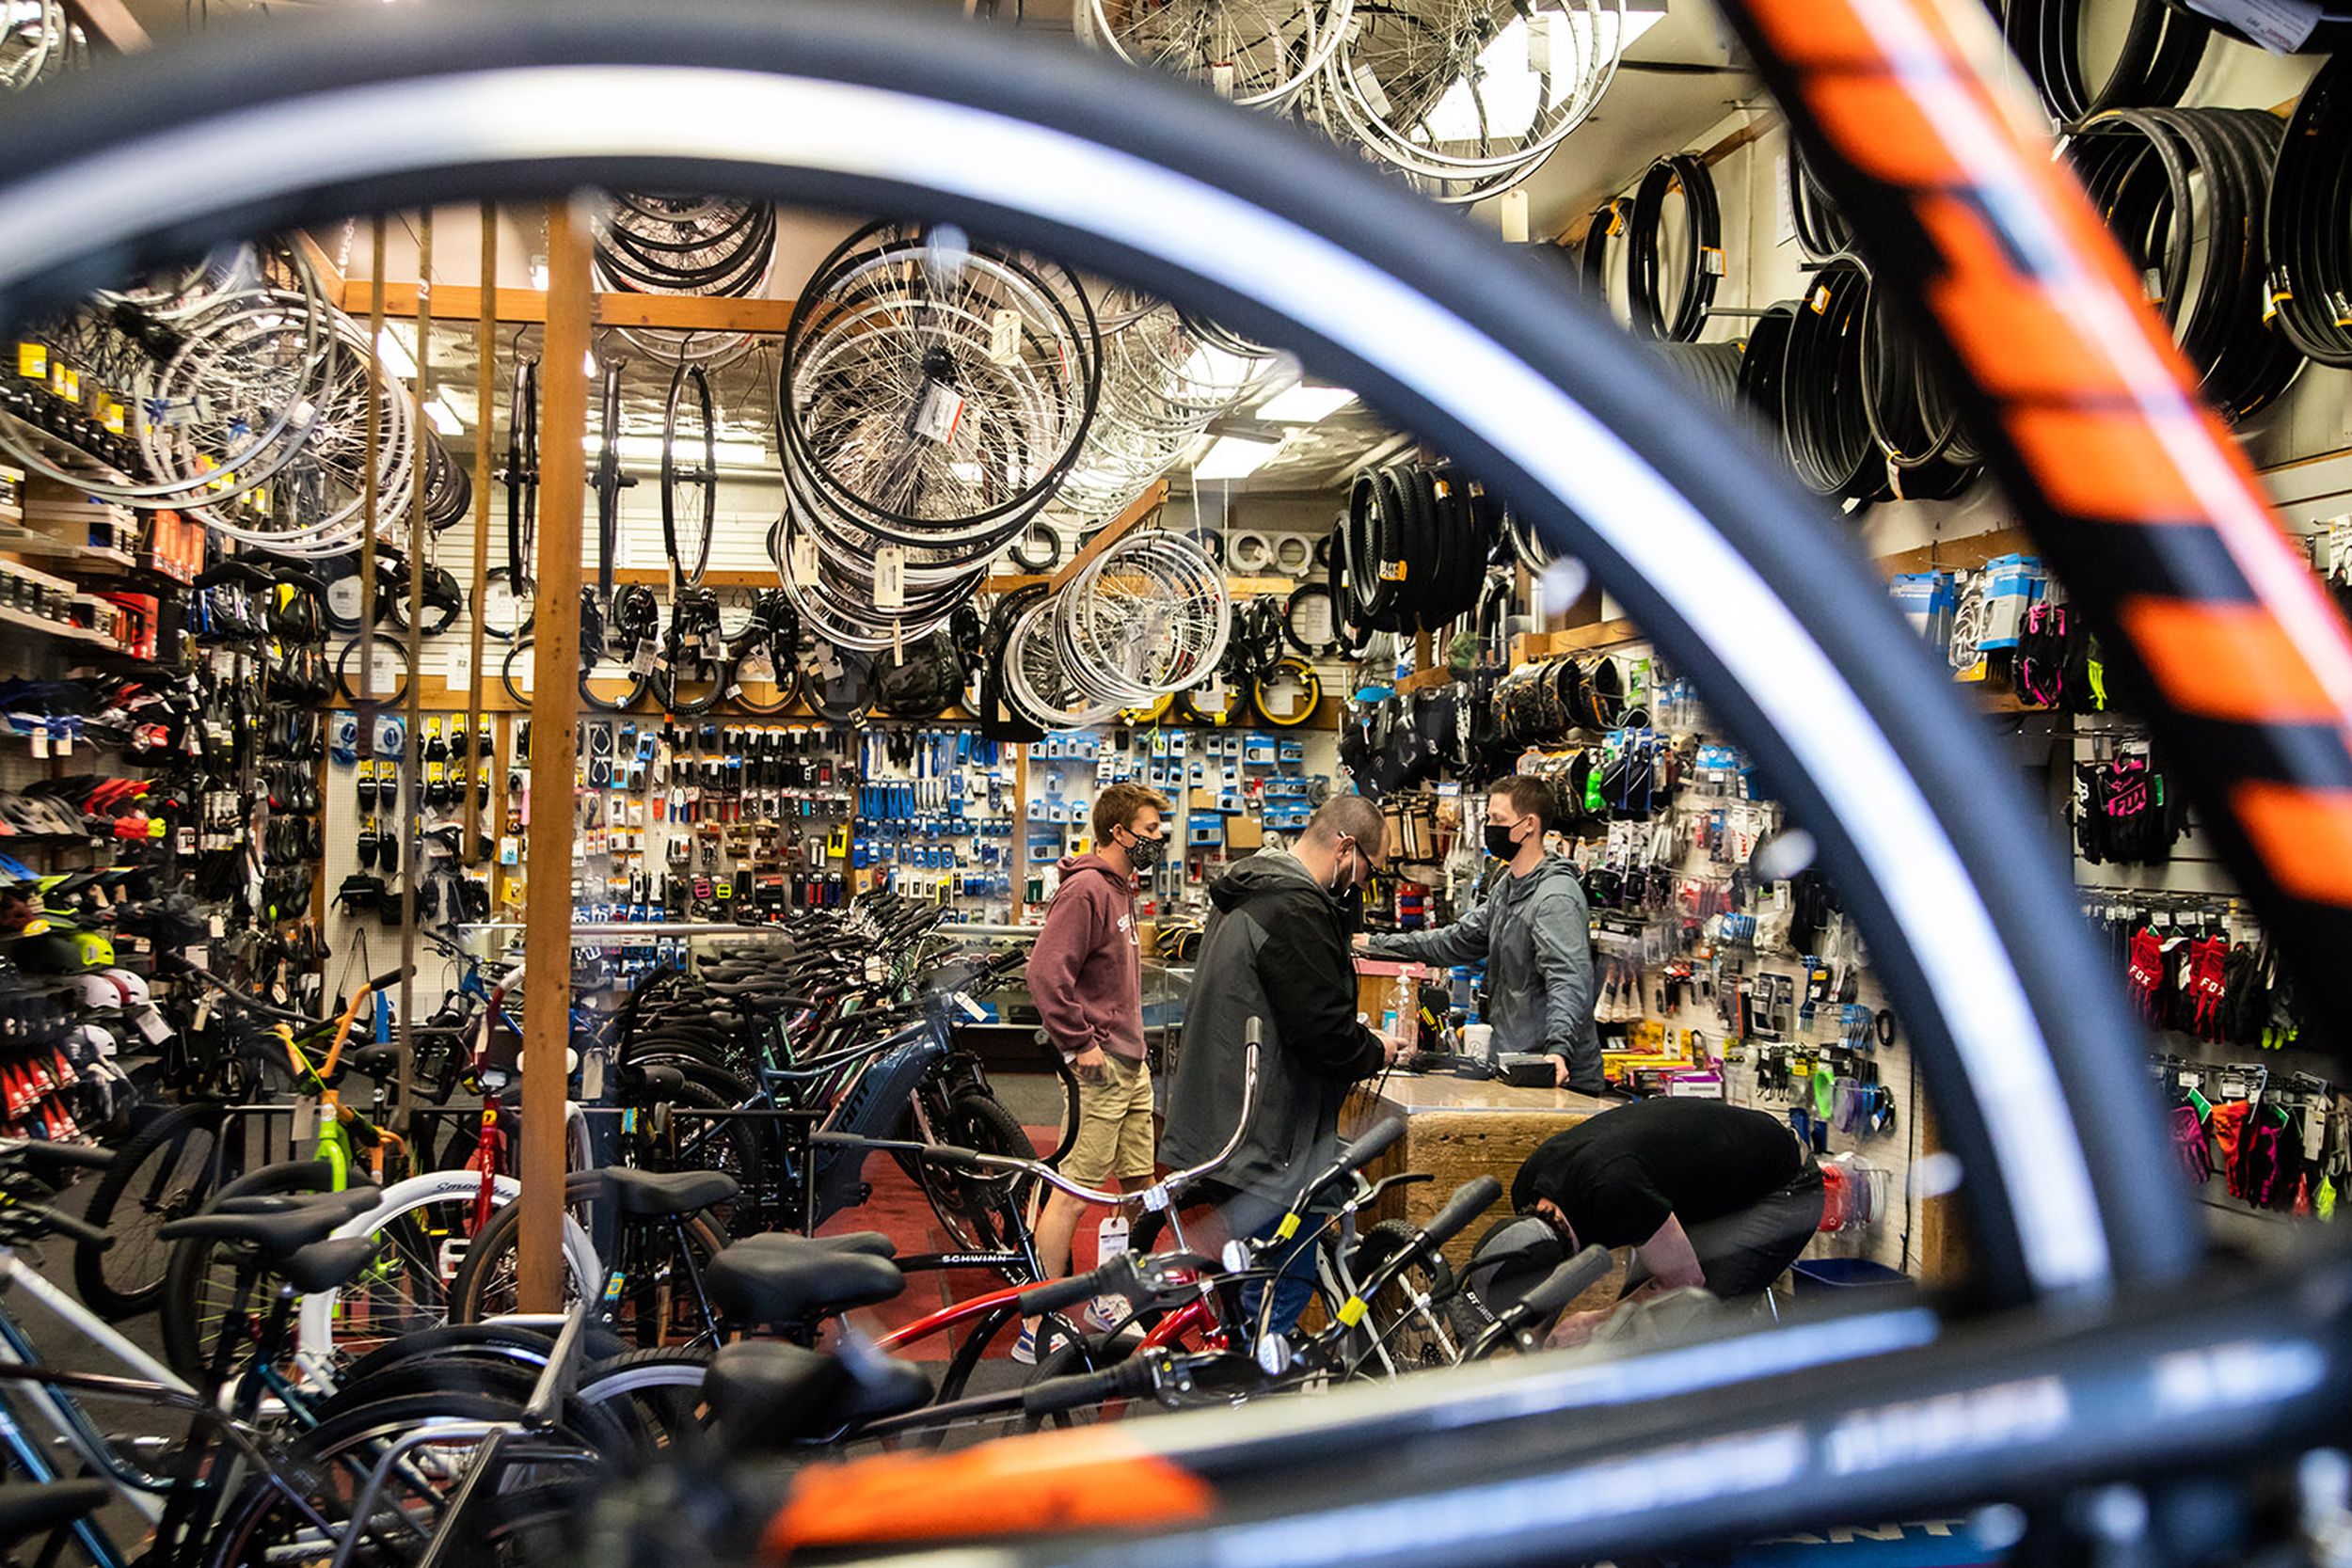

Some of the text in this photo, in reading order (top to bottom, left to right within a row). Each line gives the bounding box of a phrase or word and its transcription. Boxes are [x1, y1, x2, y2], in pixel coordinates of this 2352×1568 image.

[2129, 965, 2151, 986] FOX
[2200, 977, 2226, 997] FOX
[942, 1255, 1007, 1263] SCHWINN
[1466, 1291, 1481, 1305] DT
